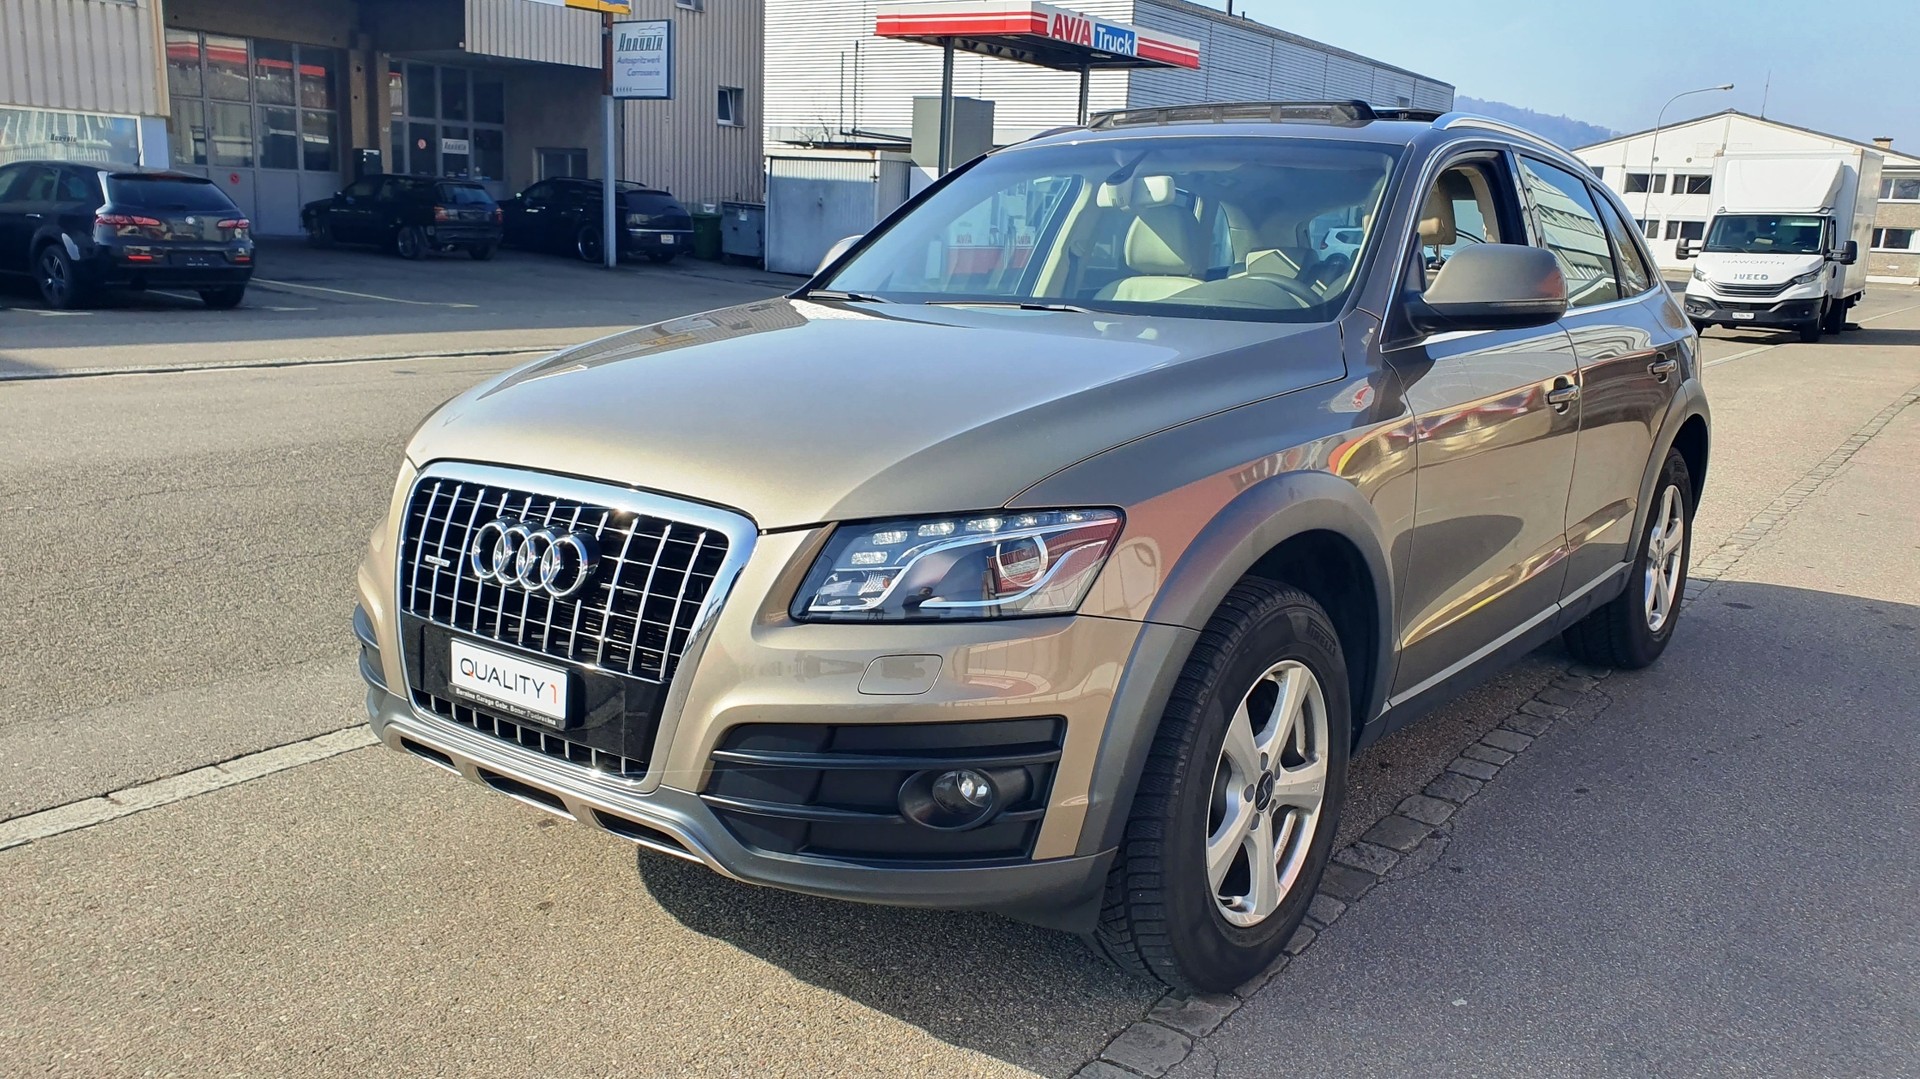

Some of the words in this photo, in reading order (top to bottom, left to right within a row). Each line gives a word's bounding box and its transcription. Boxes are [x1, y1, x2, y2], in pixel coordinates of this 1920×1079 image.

[1097, 26, 1132, 55] Truck
[460, 657, 545, 699] QUALITY
[476, 694, 494, 707] Garage
